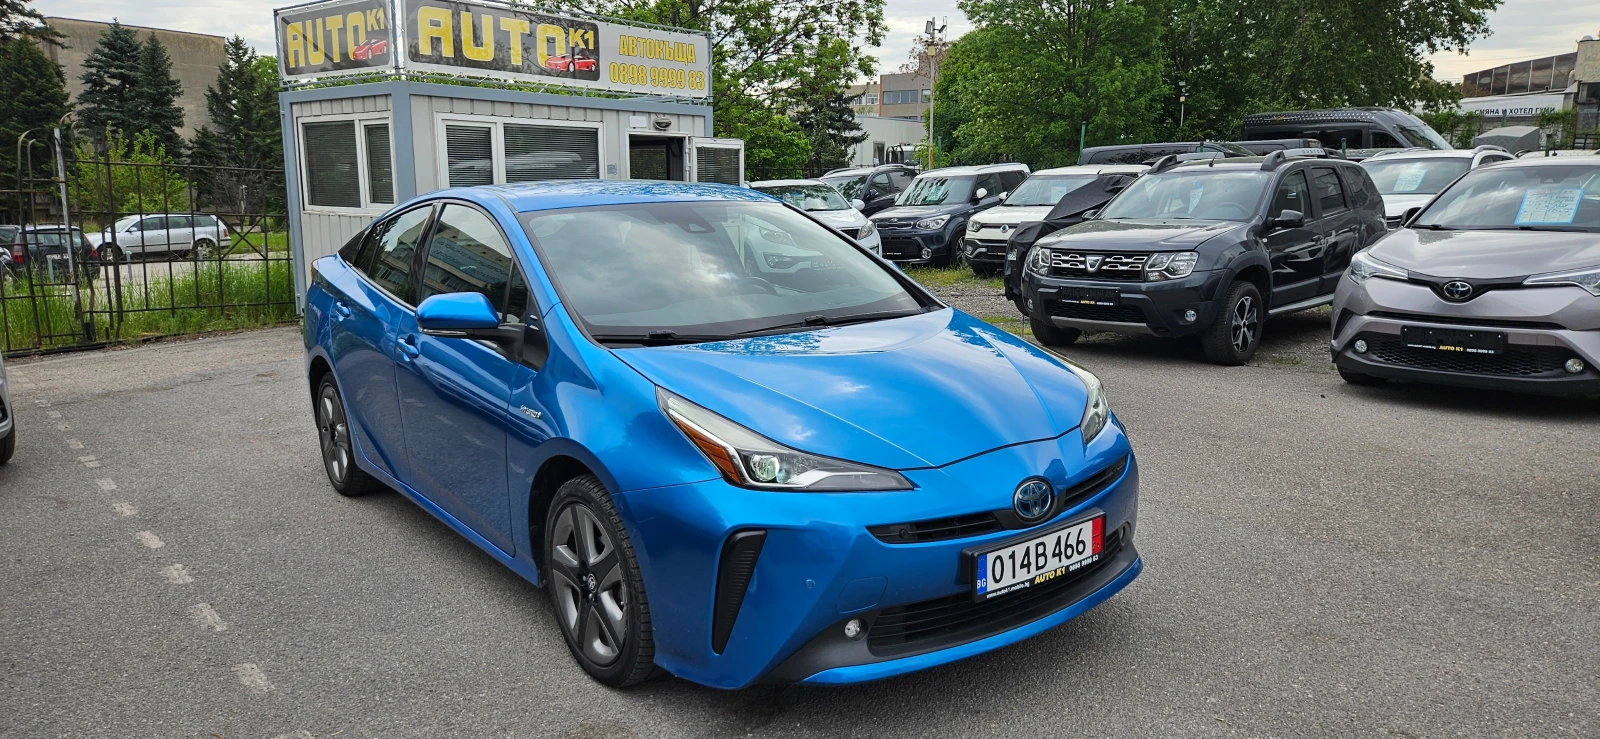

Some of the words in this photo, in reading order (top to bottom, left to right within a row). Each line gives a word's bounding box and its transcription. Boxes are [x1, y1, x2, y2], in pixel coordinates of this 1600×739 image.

[286, 11, 366, 69] AUTO
[367, 7, 385, 32] K1
[417, 6, 566, 69] AUTO
[569, 28, 594, 49] K1
[619, 35, 696, 65] АВТОКЪЩА
[609, 62, 647, 87] 0898
[650, 65, 686, 90] 9999
[688, 70, 705, 90] 83
[1474, 108, 1500, 116] СМЯНА
[1508, 107, 1533, 115] ХОТЕЛ
[1535, 106, 1556, 114] ГУМИ
[977, 578, 987, 589] BG
[1034, 571, 1055, 585] AUTO
[1056, 566, 1066, 577] K1
